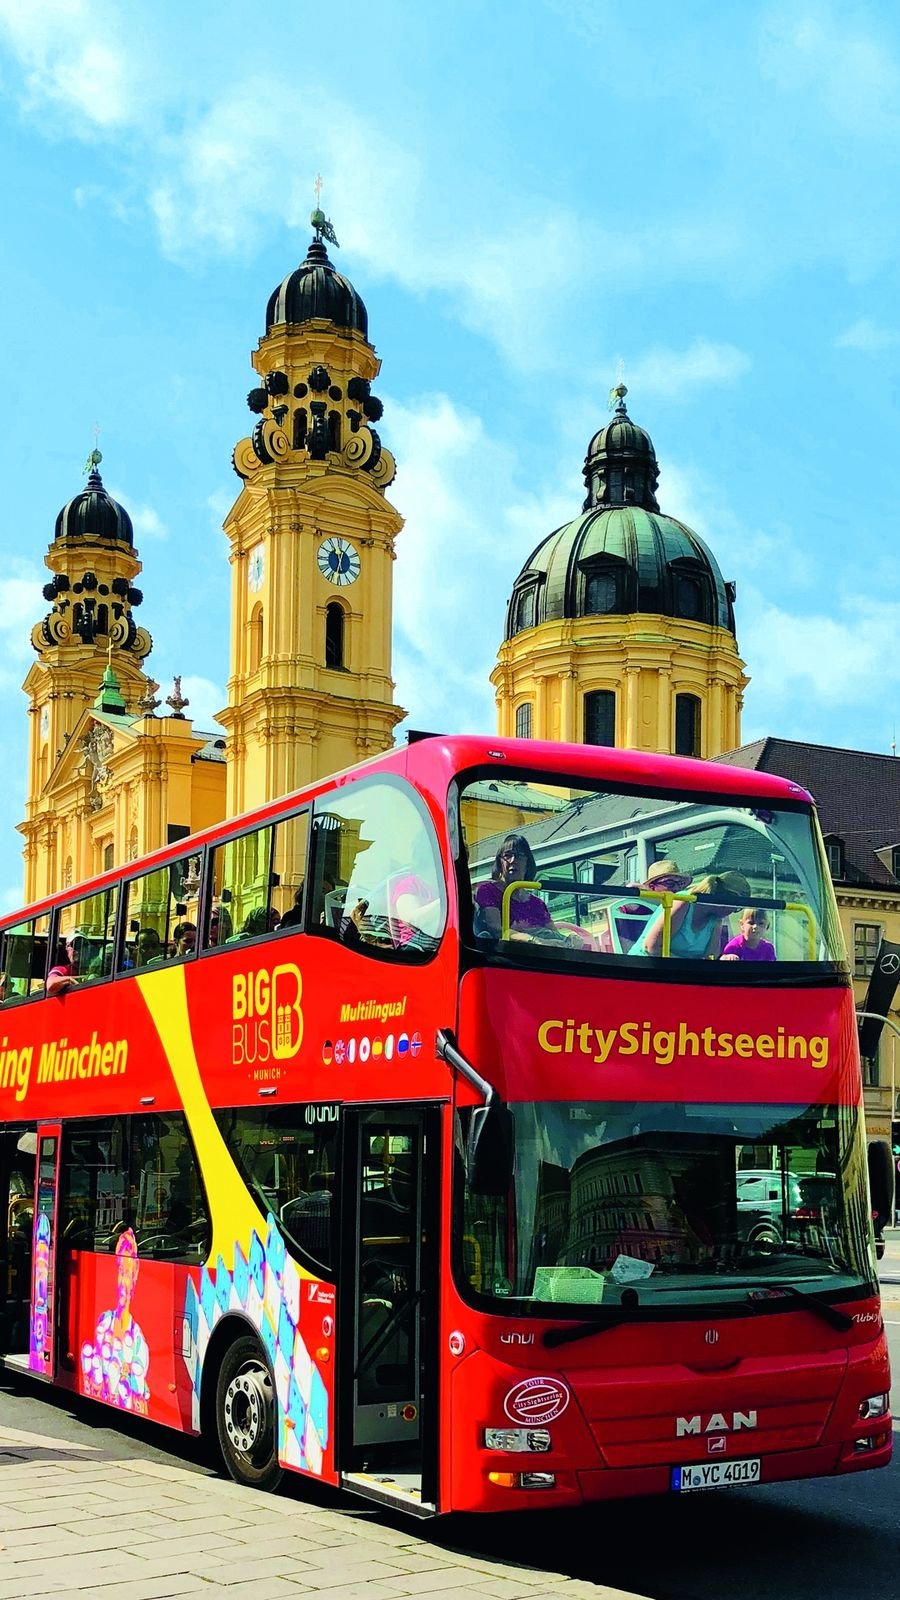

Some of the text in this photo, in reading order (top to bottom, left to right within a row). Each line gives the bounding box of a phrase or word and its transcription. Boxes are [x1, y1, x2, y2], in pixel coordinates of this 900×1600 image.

[232, 968, 270, 1020] BIG
[340, 995, 407, 1023] Multilingual
[232, 1019, 271, 1065] BUS
[537, 1019, 829, 1068] CitySightseeing
[37, 1031, 128, 1084] München
[253, 1068, 281, 1080] MUNICH
[523, 1379, 545, 1389] TOUR
[512, 1392, 563, 1410] CitySightseeing
[676, 1410, 757, 1436] MAN
[682, 1462, 759, 1486] M YC 4019
